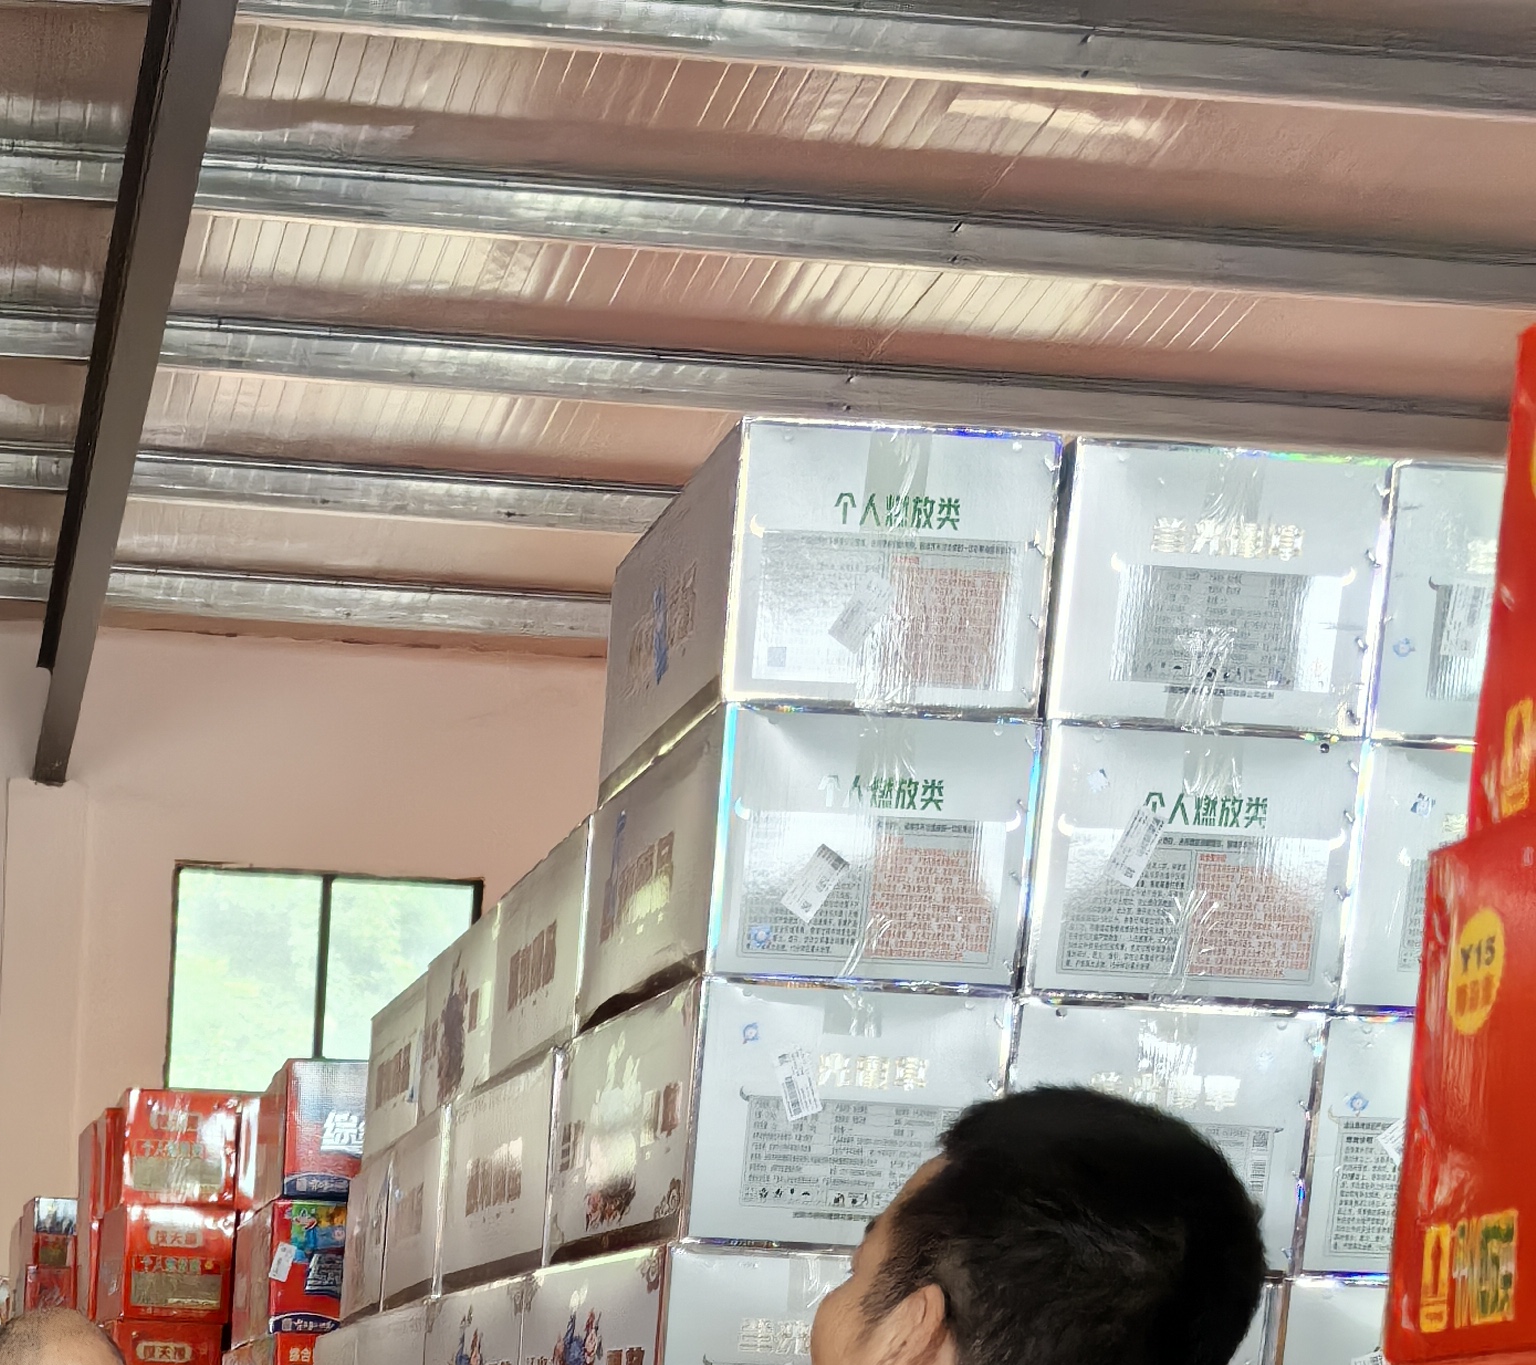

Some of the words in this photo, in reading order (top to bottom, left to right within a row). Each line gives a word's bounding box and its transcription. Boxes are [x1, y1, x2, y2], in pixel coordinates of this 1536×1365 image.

[835, 492, 962, 533] 个人燃放类
[819, 774, 944, 816] 个人燃放类
[1143, 789, 1270, 831] 个人燃放类
[1460, 932, 1497, 975] Y15
[320, 1110, 366, 1156] 综
